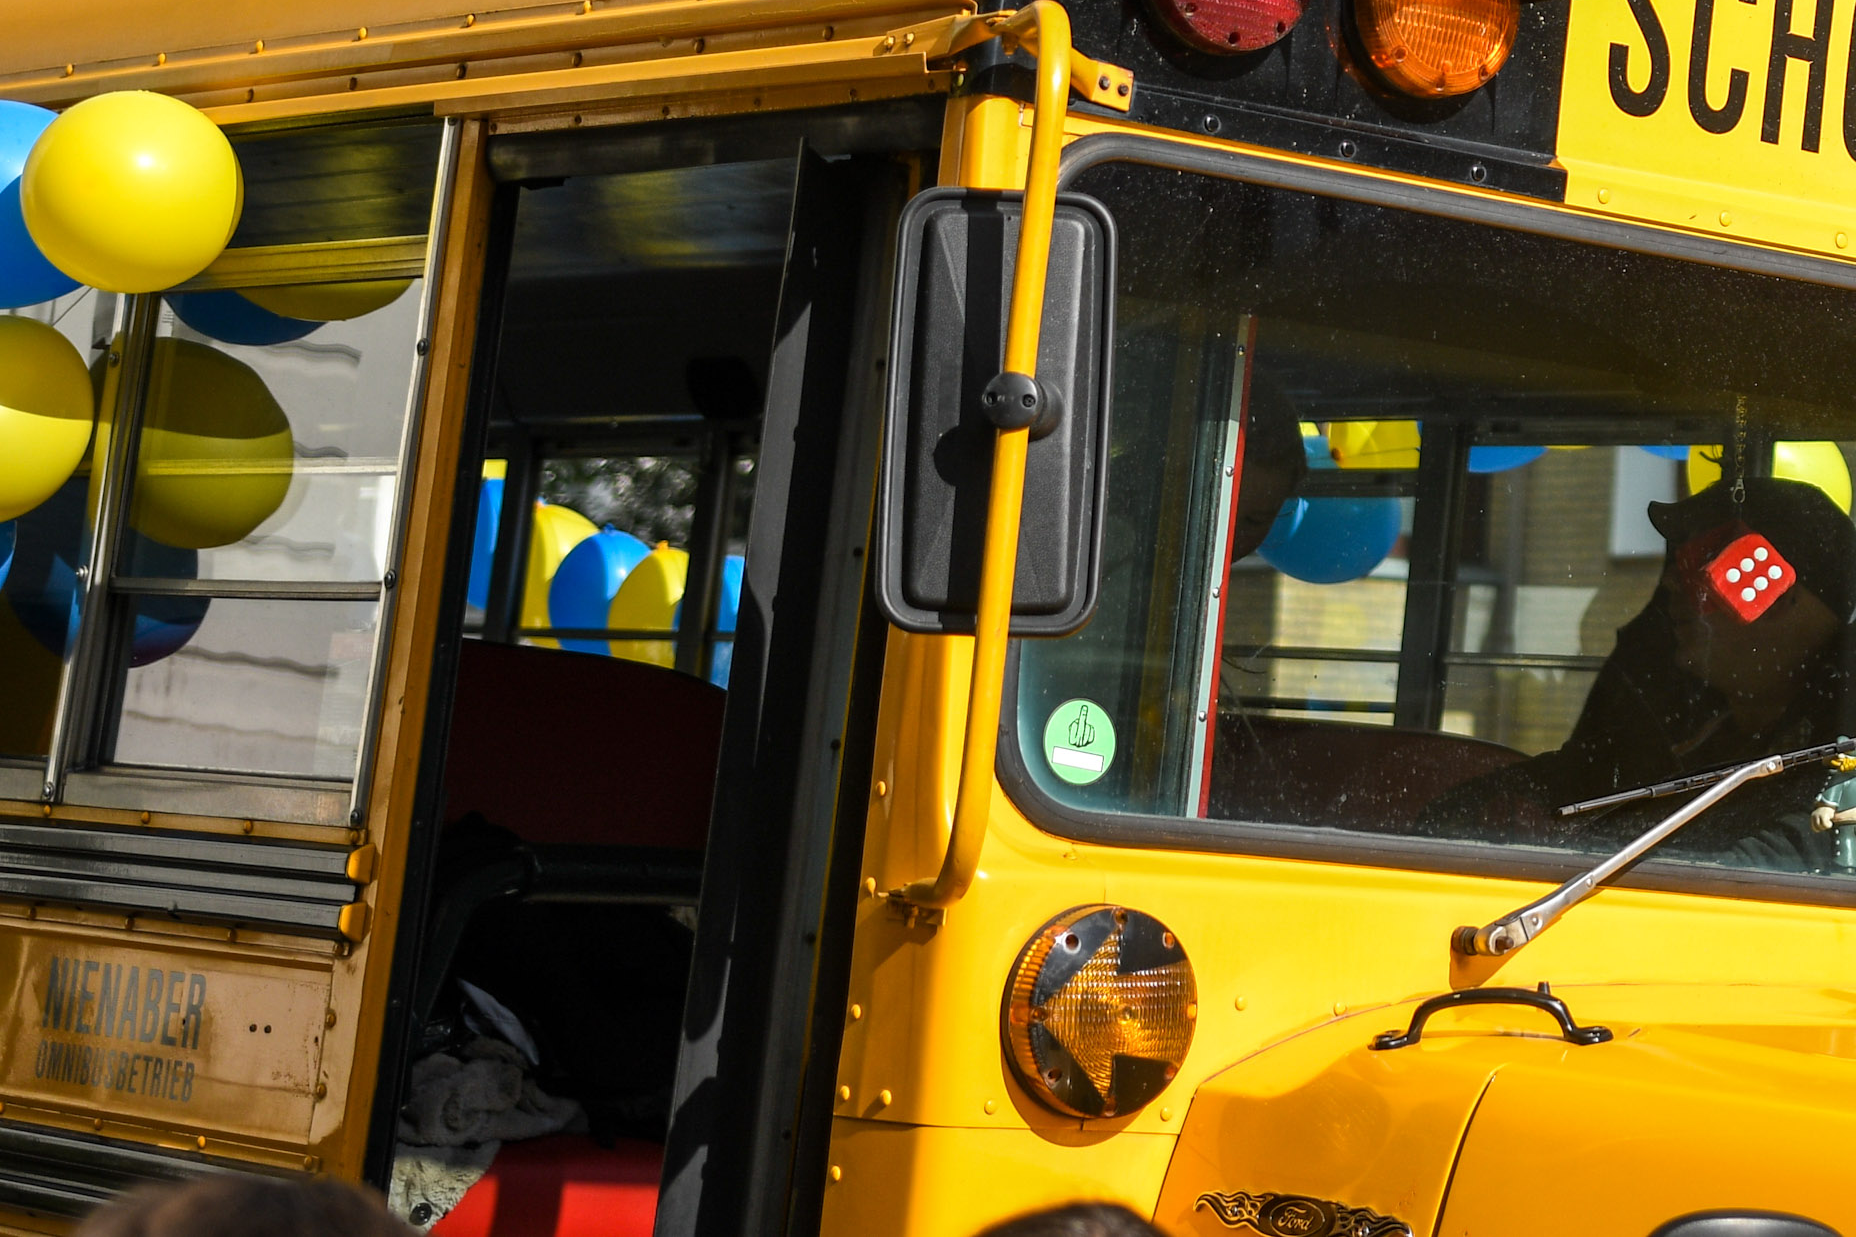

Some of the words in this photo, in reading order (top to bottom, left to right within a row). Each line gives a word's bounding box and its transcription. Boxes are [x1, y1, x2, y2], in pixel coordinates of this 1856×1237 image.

[42, 956, 207, 1050] NIENABER
[35, 1041, 195, 1102] OMNIBUSBETRIEB
[1277, 1206, 1314, 1231] Ford
